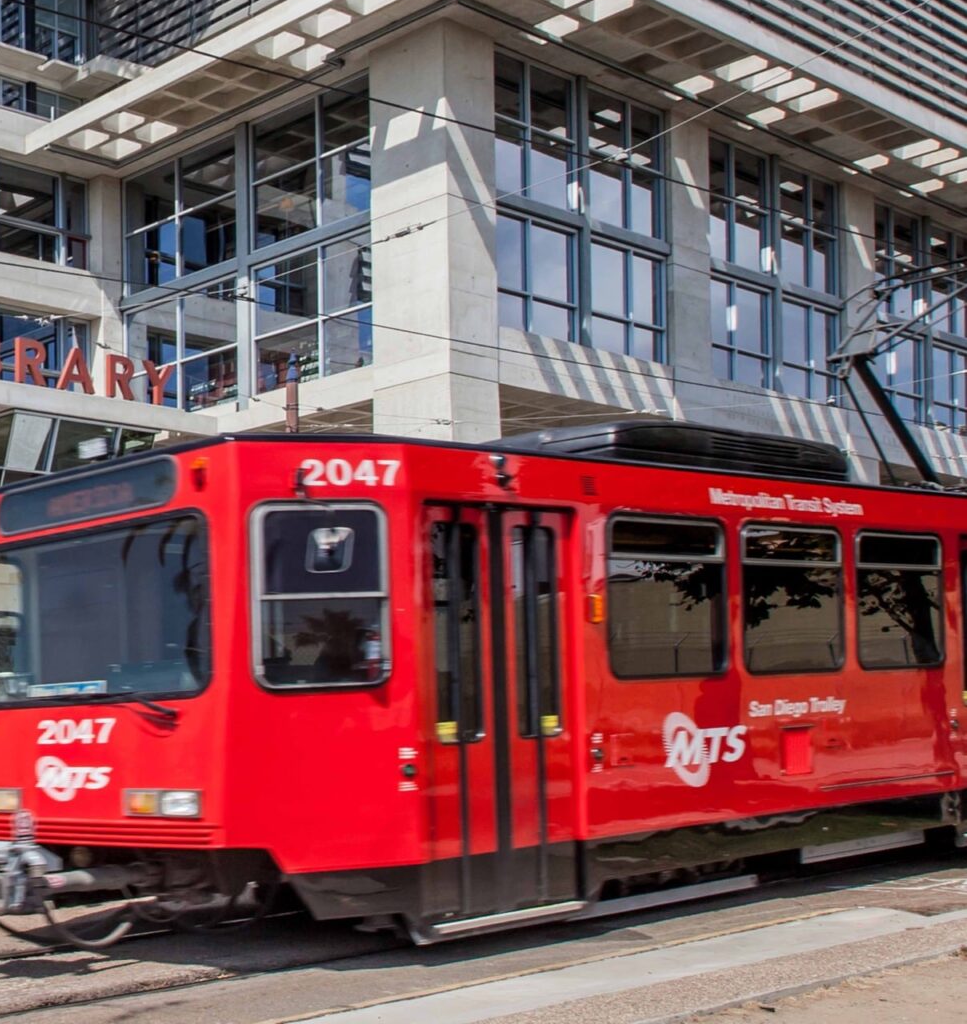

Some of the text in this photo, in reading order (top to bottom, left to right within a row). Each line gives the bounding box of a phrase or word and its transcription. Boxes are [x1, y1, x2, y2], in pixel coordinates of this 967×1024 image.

[300, 458, 402, 487] 2047
[708, 487, 864, 517] Metropolitan Transit System
[748, 696, 846, 717] San Diego Trolley
[36, 717, 117, 745] 2047
[663, 721, 748, 771] MTS
[35, 763, 114, 792] MTS
